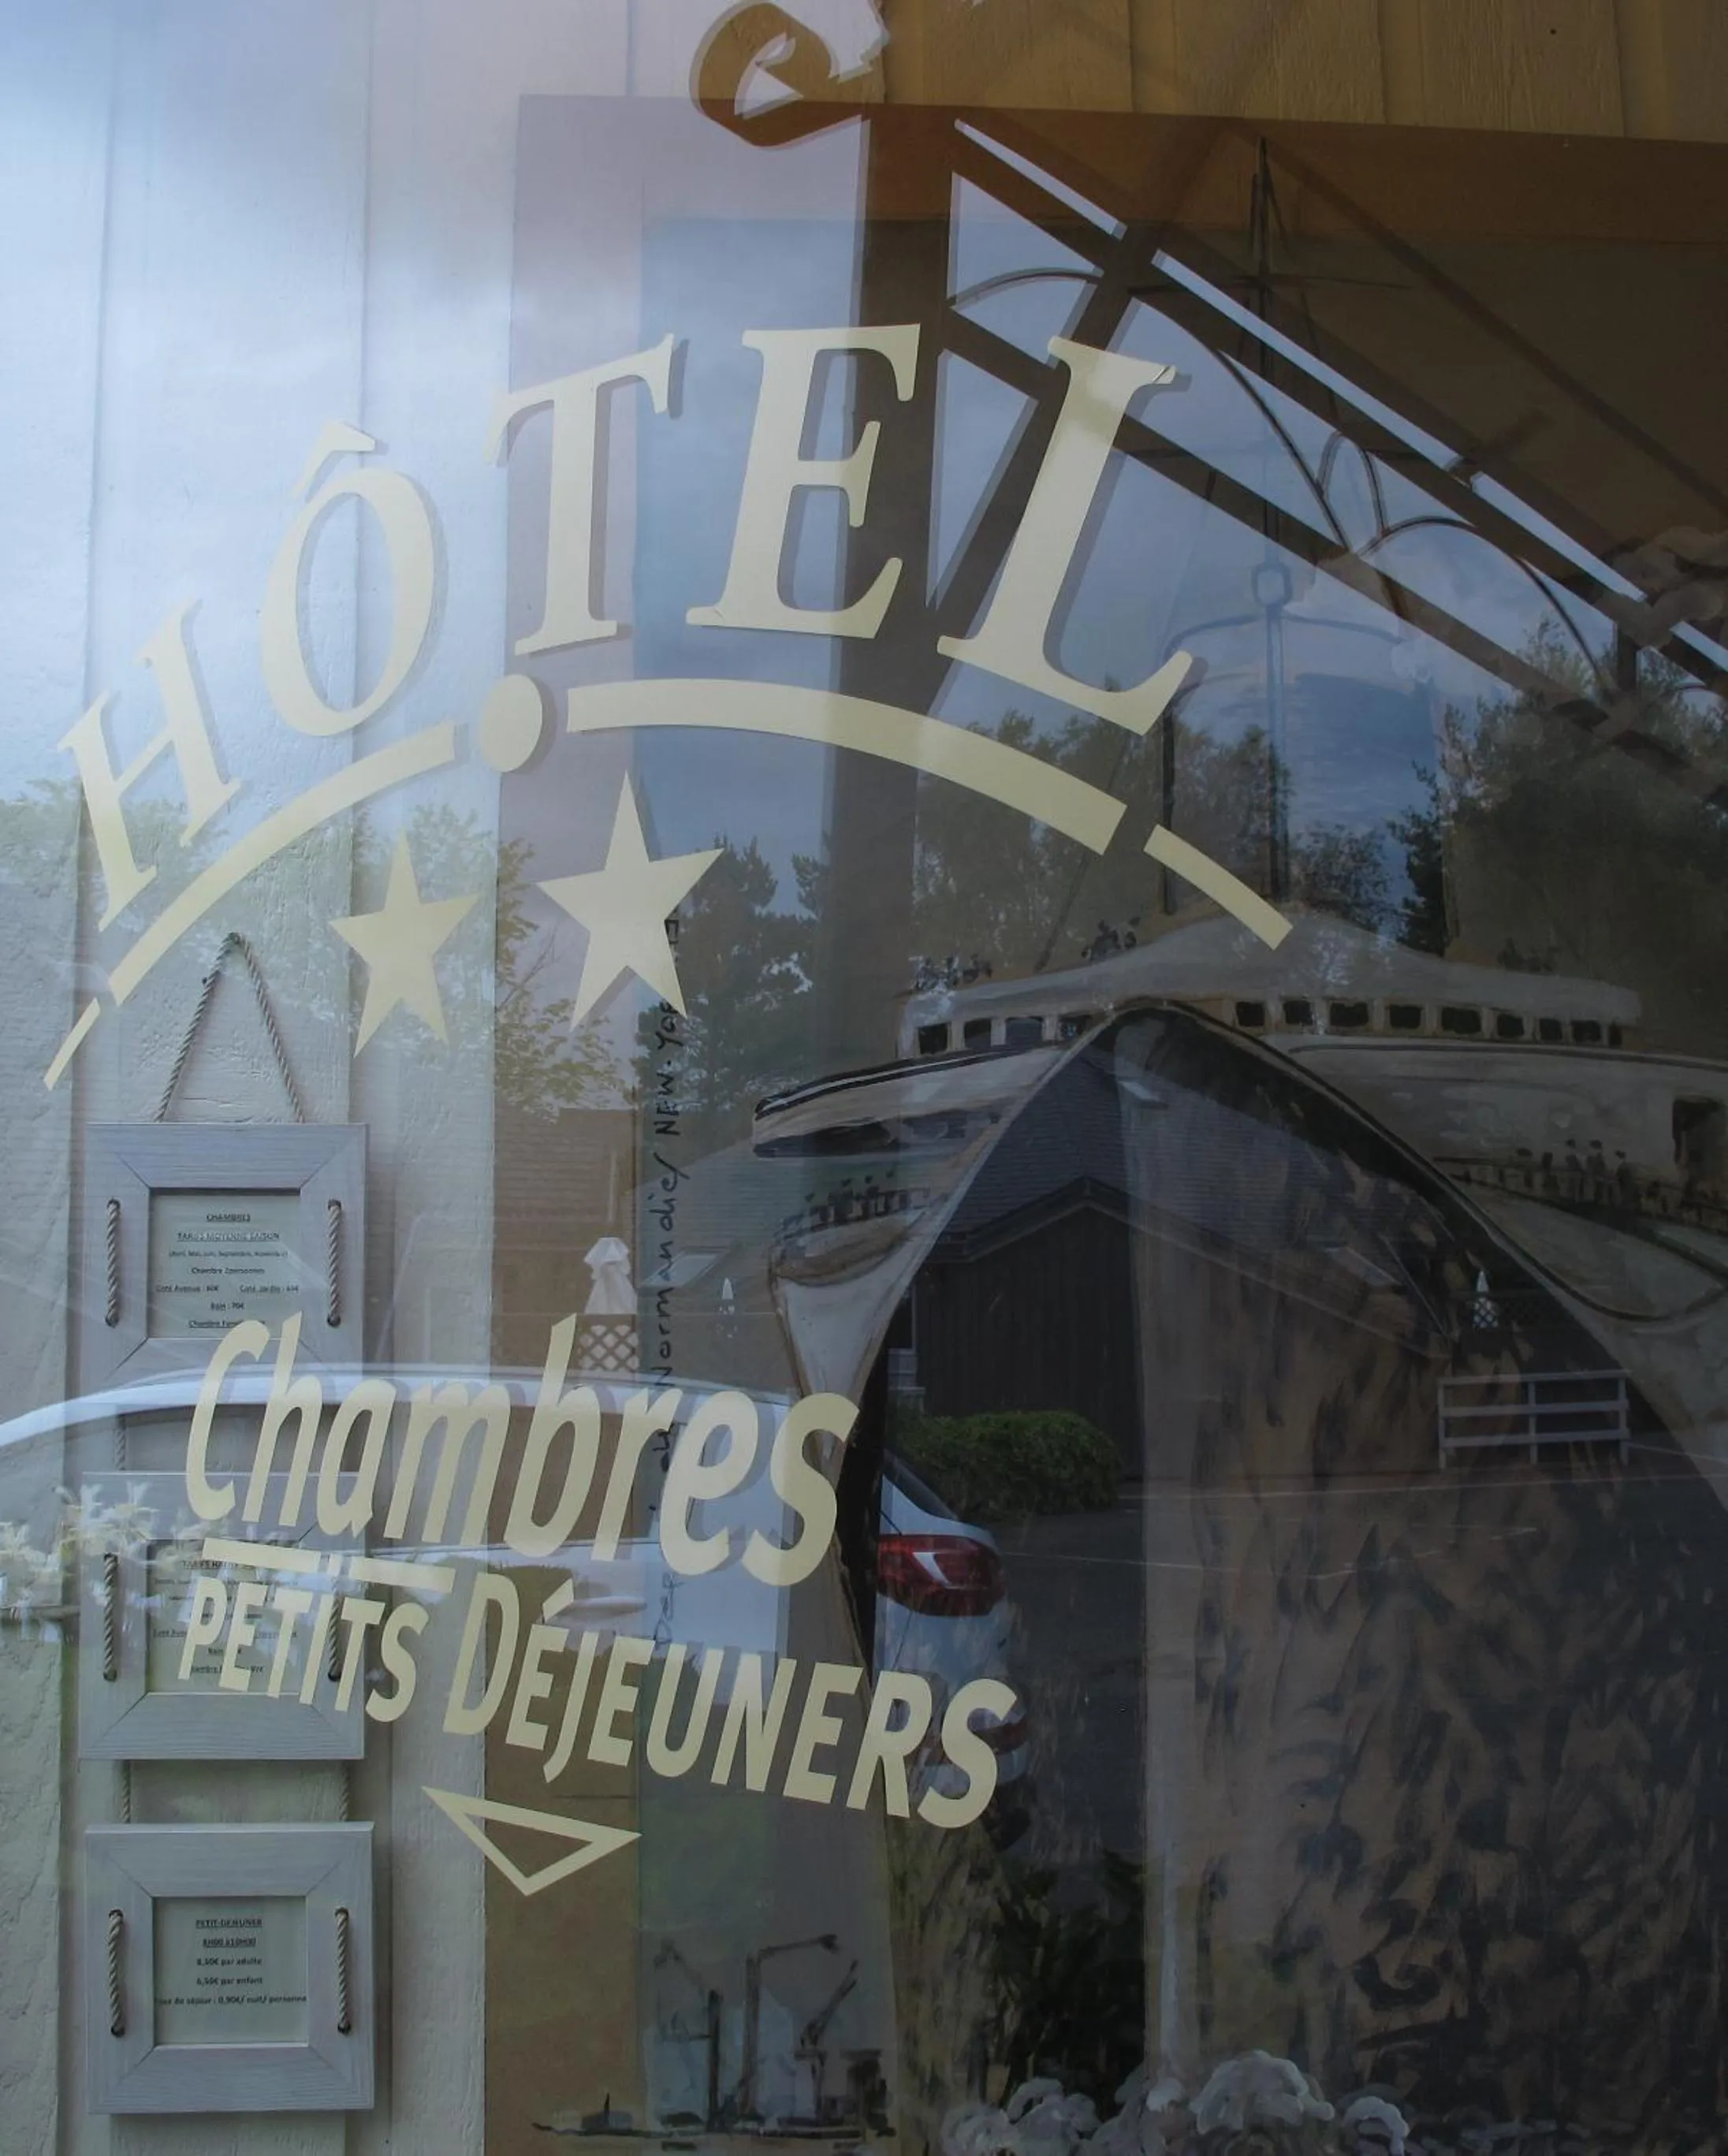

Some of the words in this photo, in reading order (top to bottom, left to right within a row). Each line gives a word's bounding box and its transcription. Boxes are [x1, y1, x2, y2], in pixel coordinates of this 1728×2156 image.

[57, 323, 1192, 933] HÔTEL
[185, 1311, 860, 1586] Chambres
[177, 1569, 430, 1722] PETITS
[443, 1571, 1017, 1828] DÉJEUNERS
